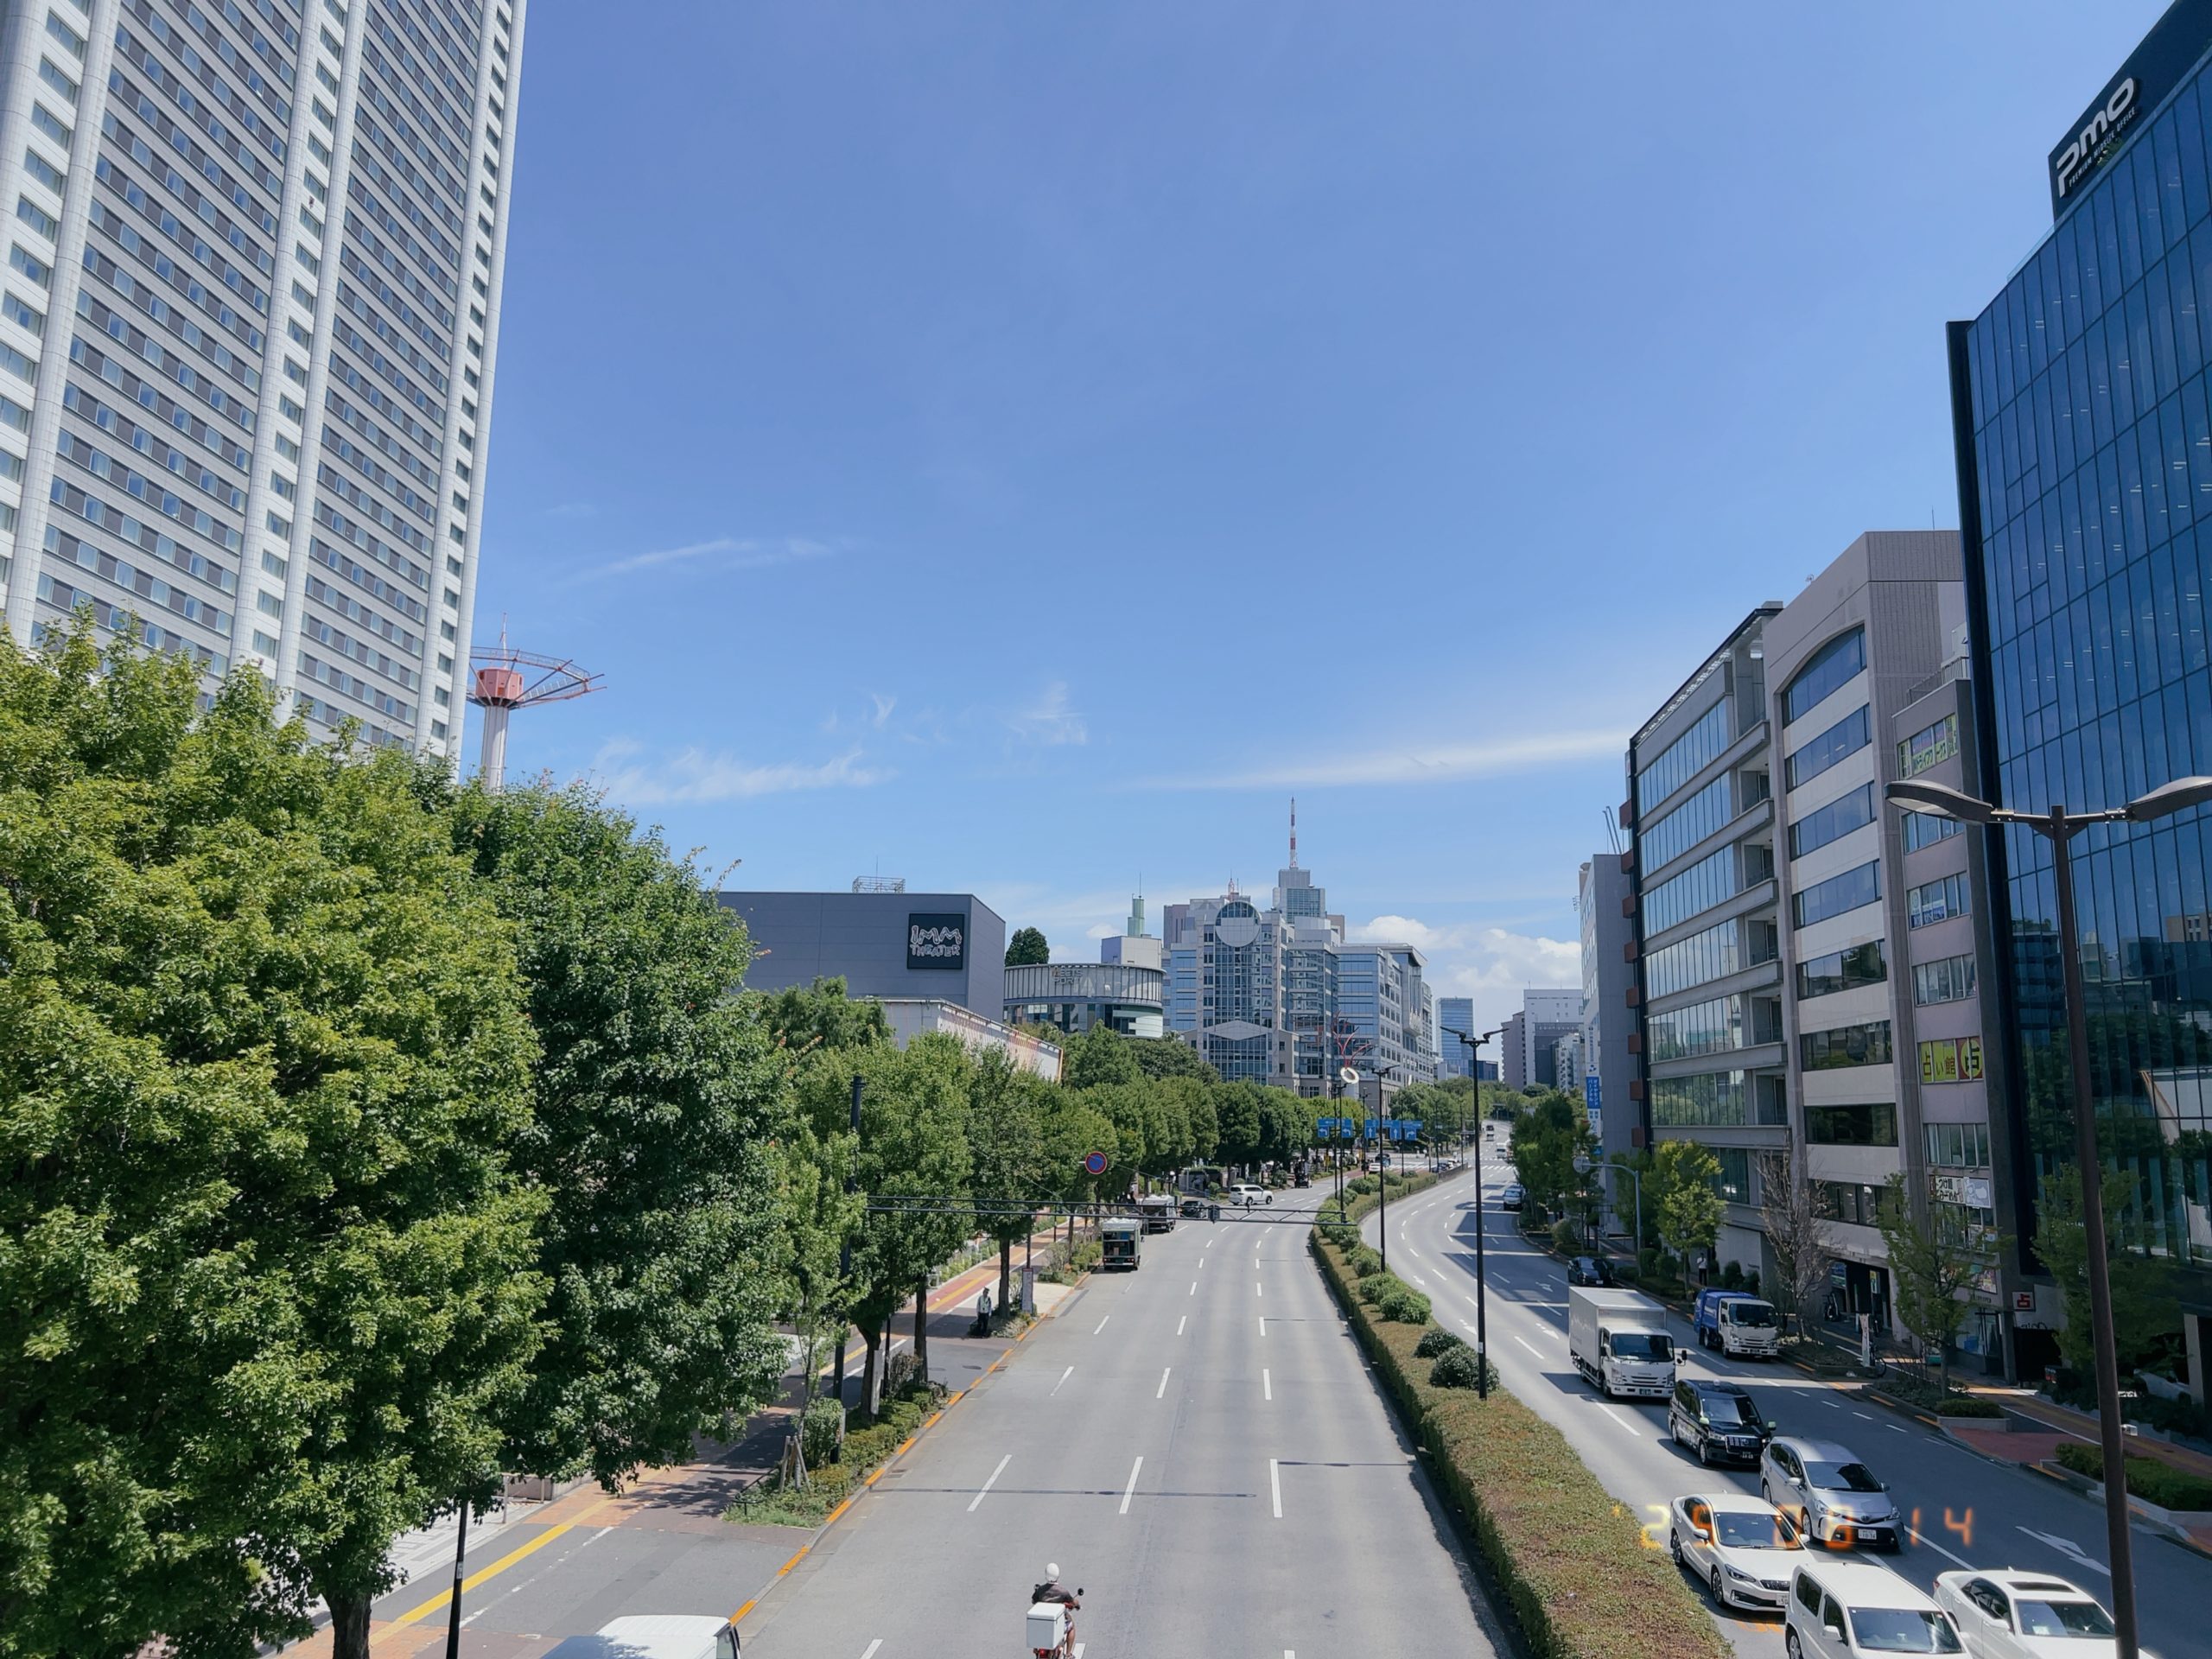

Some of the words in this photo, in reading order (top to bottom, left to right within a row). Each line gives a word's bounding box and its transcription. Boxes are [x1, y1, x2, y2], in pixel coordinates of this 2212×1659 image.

[2069, 156, 2093, 188] PREMIUM
[2093, 130, 2116, 158] MIDSIZE
[2116, 105, 2137, 132] OFFICE
[910, 925, 963, 945] IMM
[910, 944, 961, 957] THEATER
[1052, 967, 1084, 977] MEETS
[1923, 1050, 1956, 1076] 占い館
